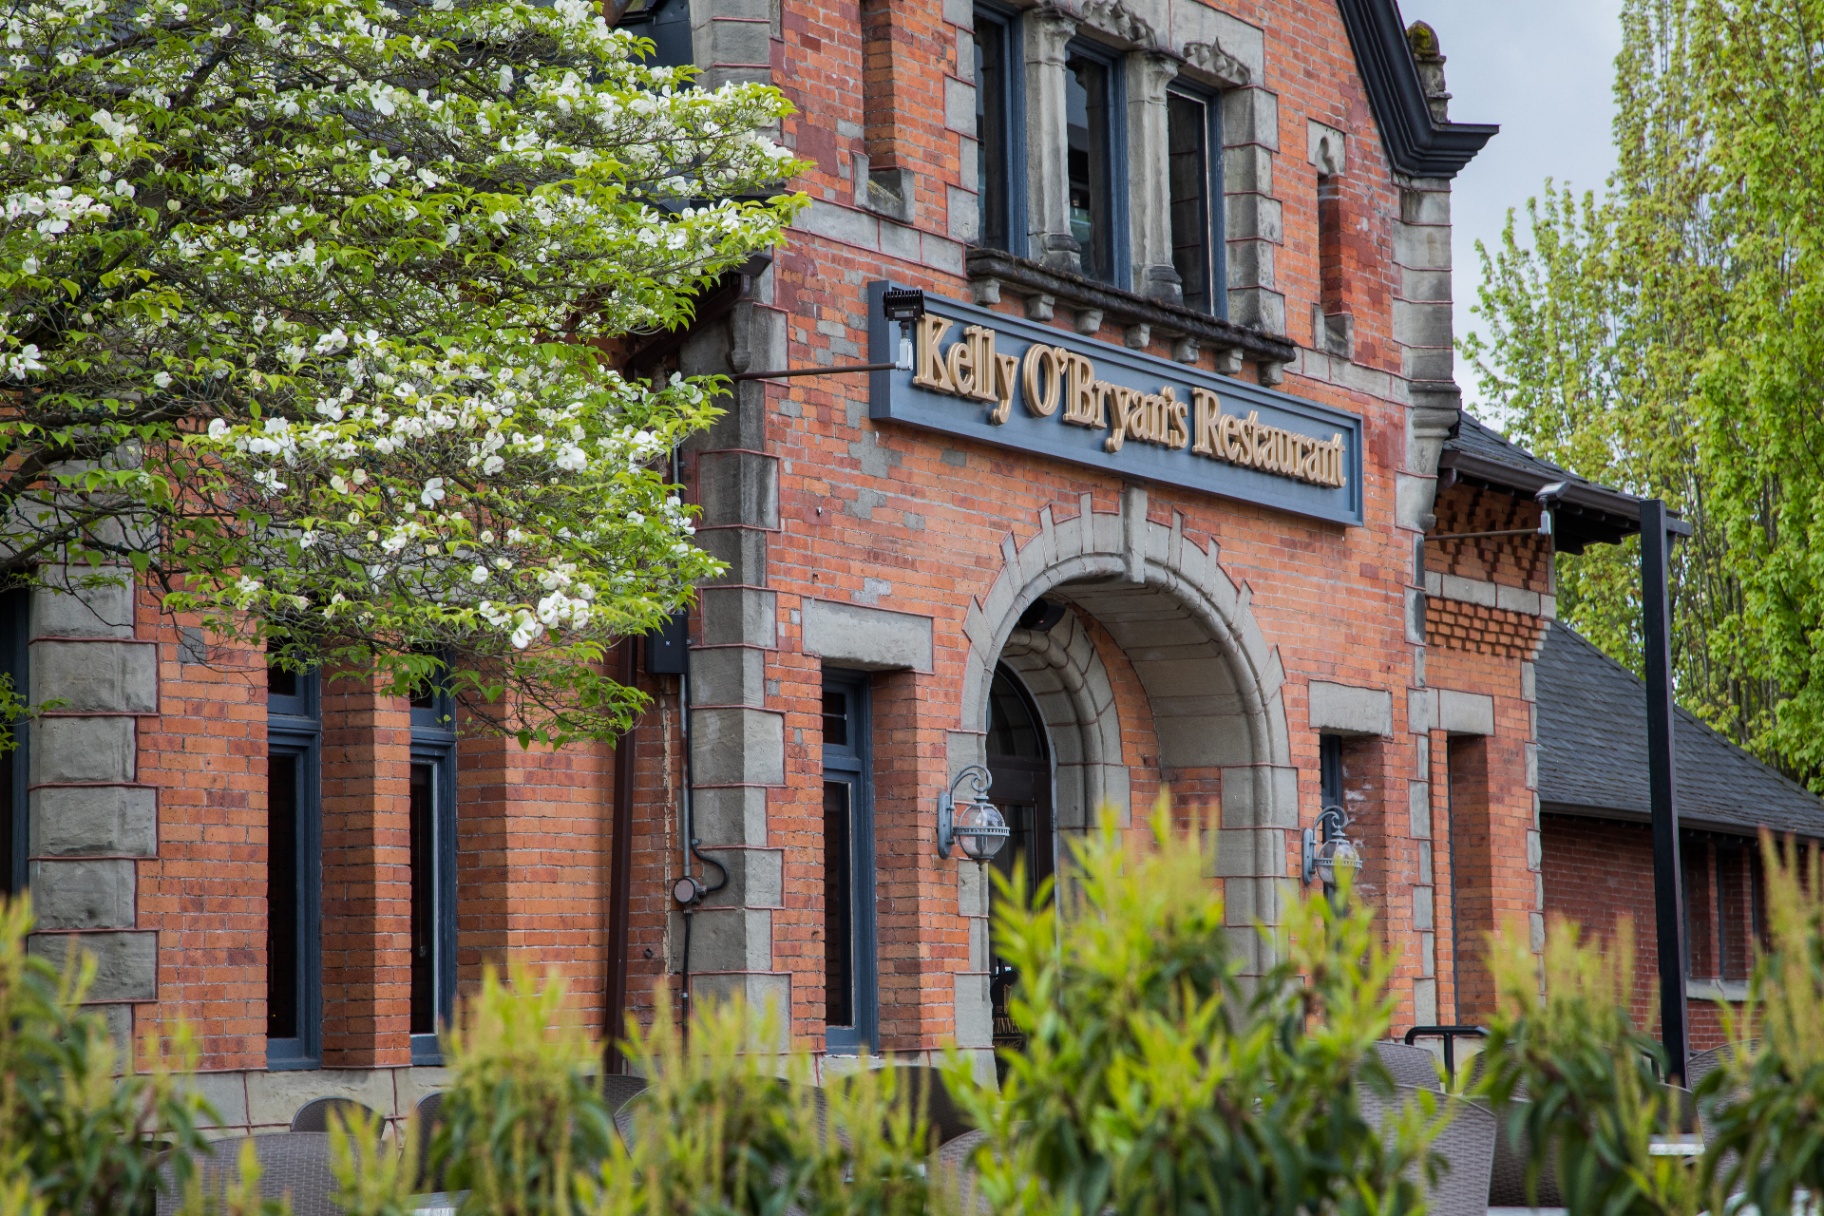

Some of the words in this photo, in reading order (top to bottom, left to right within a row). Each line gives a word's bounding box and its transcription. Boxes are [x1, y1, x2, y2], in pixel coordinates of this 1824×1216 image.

[913, 312, 1020, 426] Kelly
[1022, 343, 1189, 453] O'Bryan's
[1192, 386, 1347, 489] Restaurant
